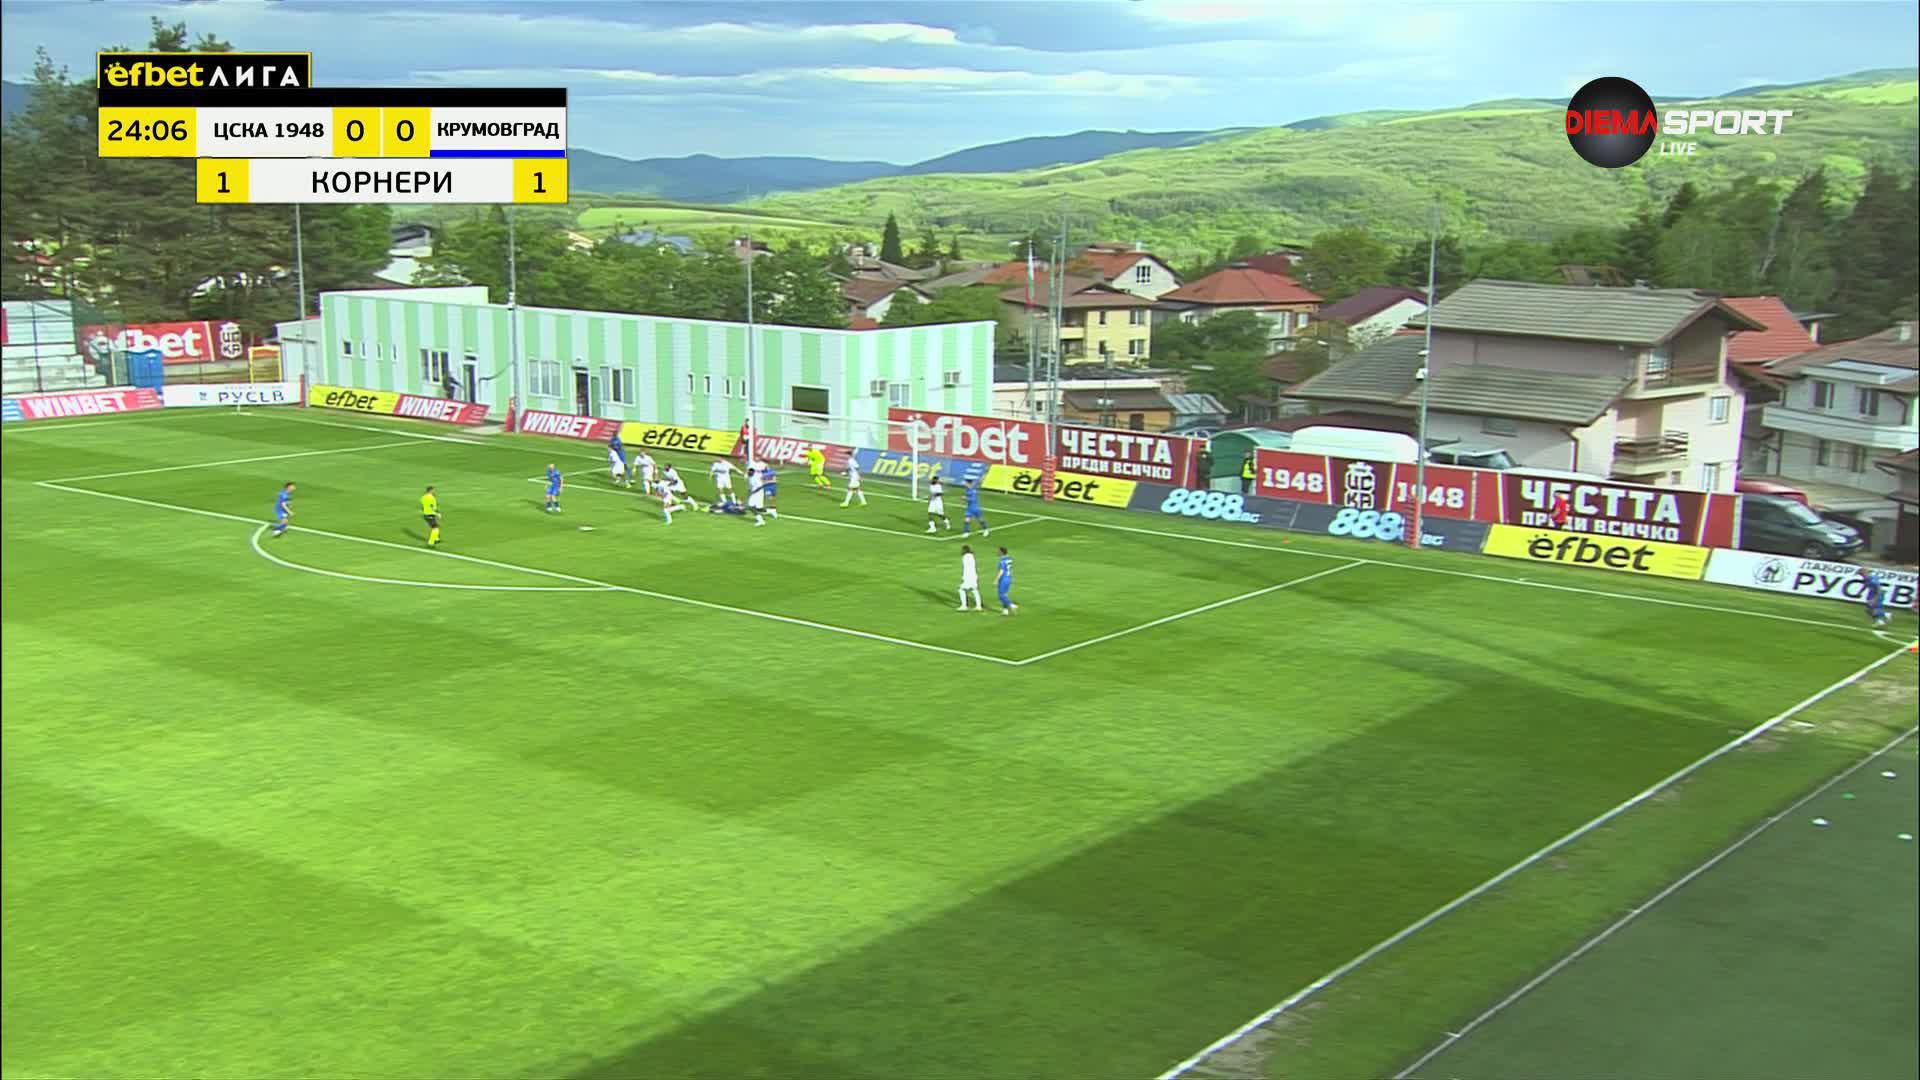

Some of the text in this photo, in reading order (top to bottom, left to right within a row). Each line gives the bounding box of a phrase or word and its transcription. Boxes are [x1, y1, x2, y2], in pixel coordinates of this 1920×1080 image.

[25, 391, 128, 418] WINBET
[398, 396, 468, 422] WINBET
[522, 412, 599, 438] WINBET
[1061, 429, 1173, 465] ЧЕСТТА
[1061, 456, 1172, 480] ПРЕДИ ВСИЧКО
[1262, 467, 1324, 493] 1948
[1593, 519, 1680, 542] ВСИЧКО
